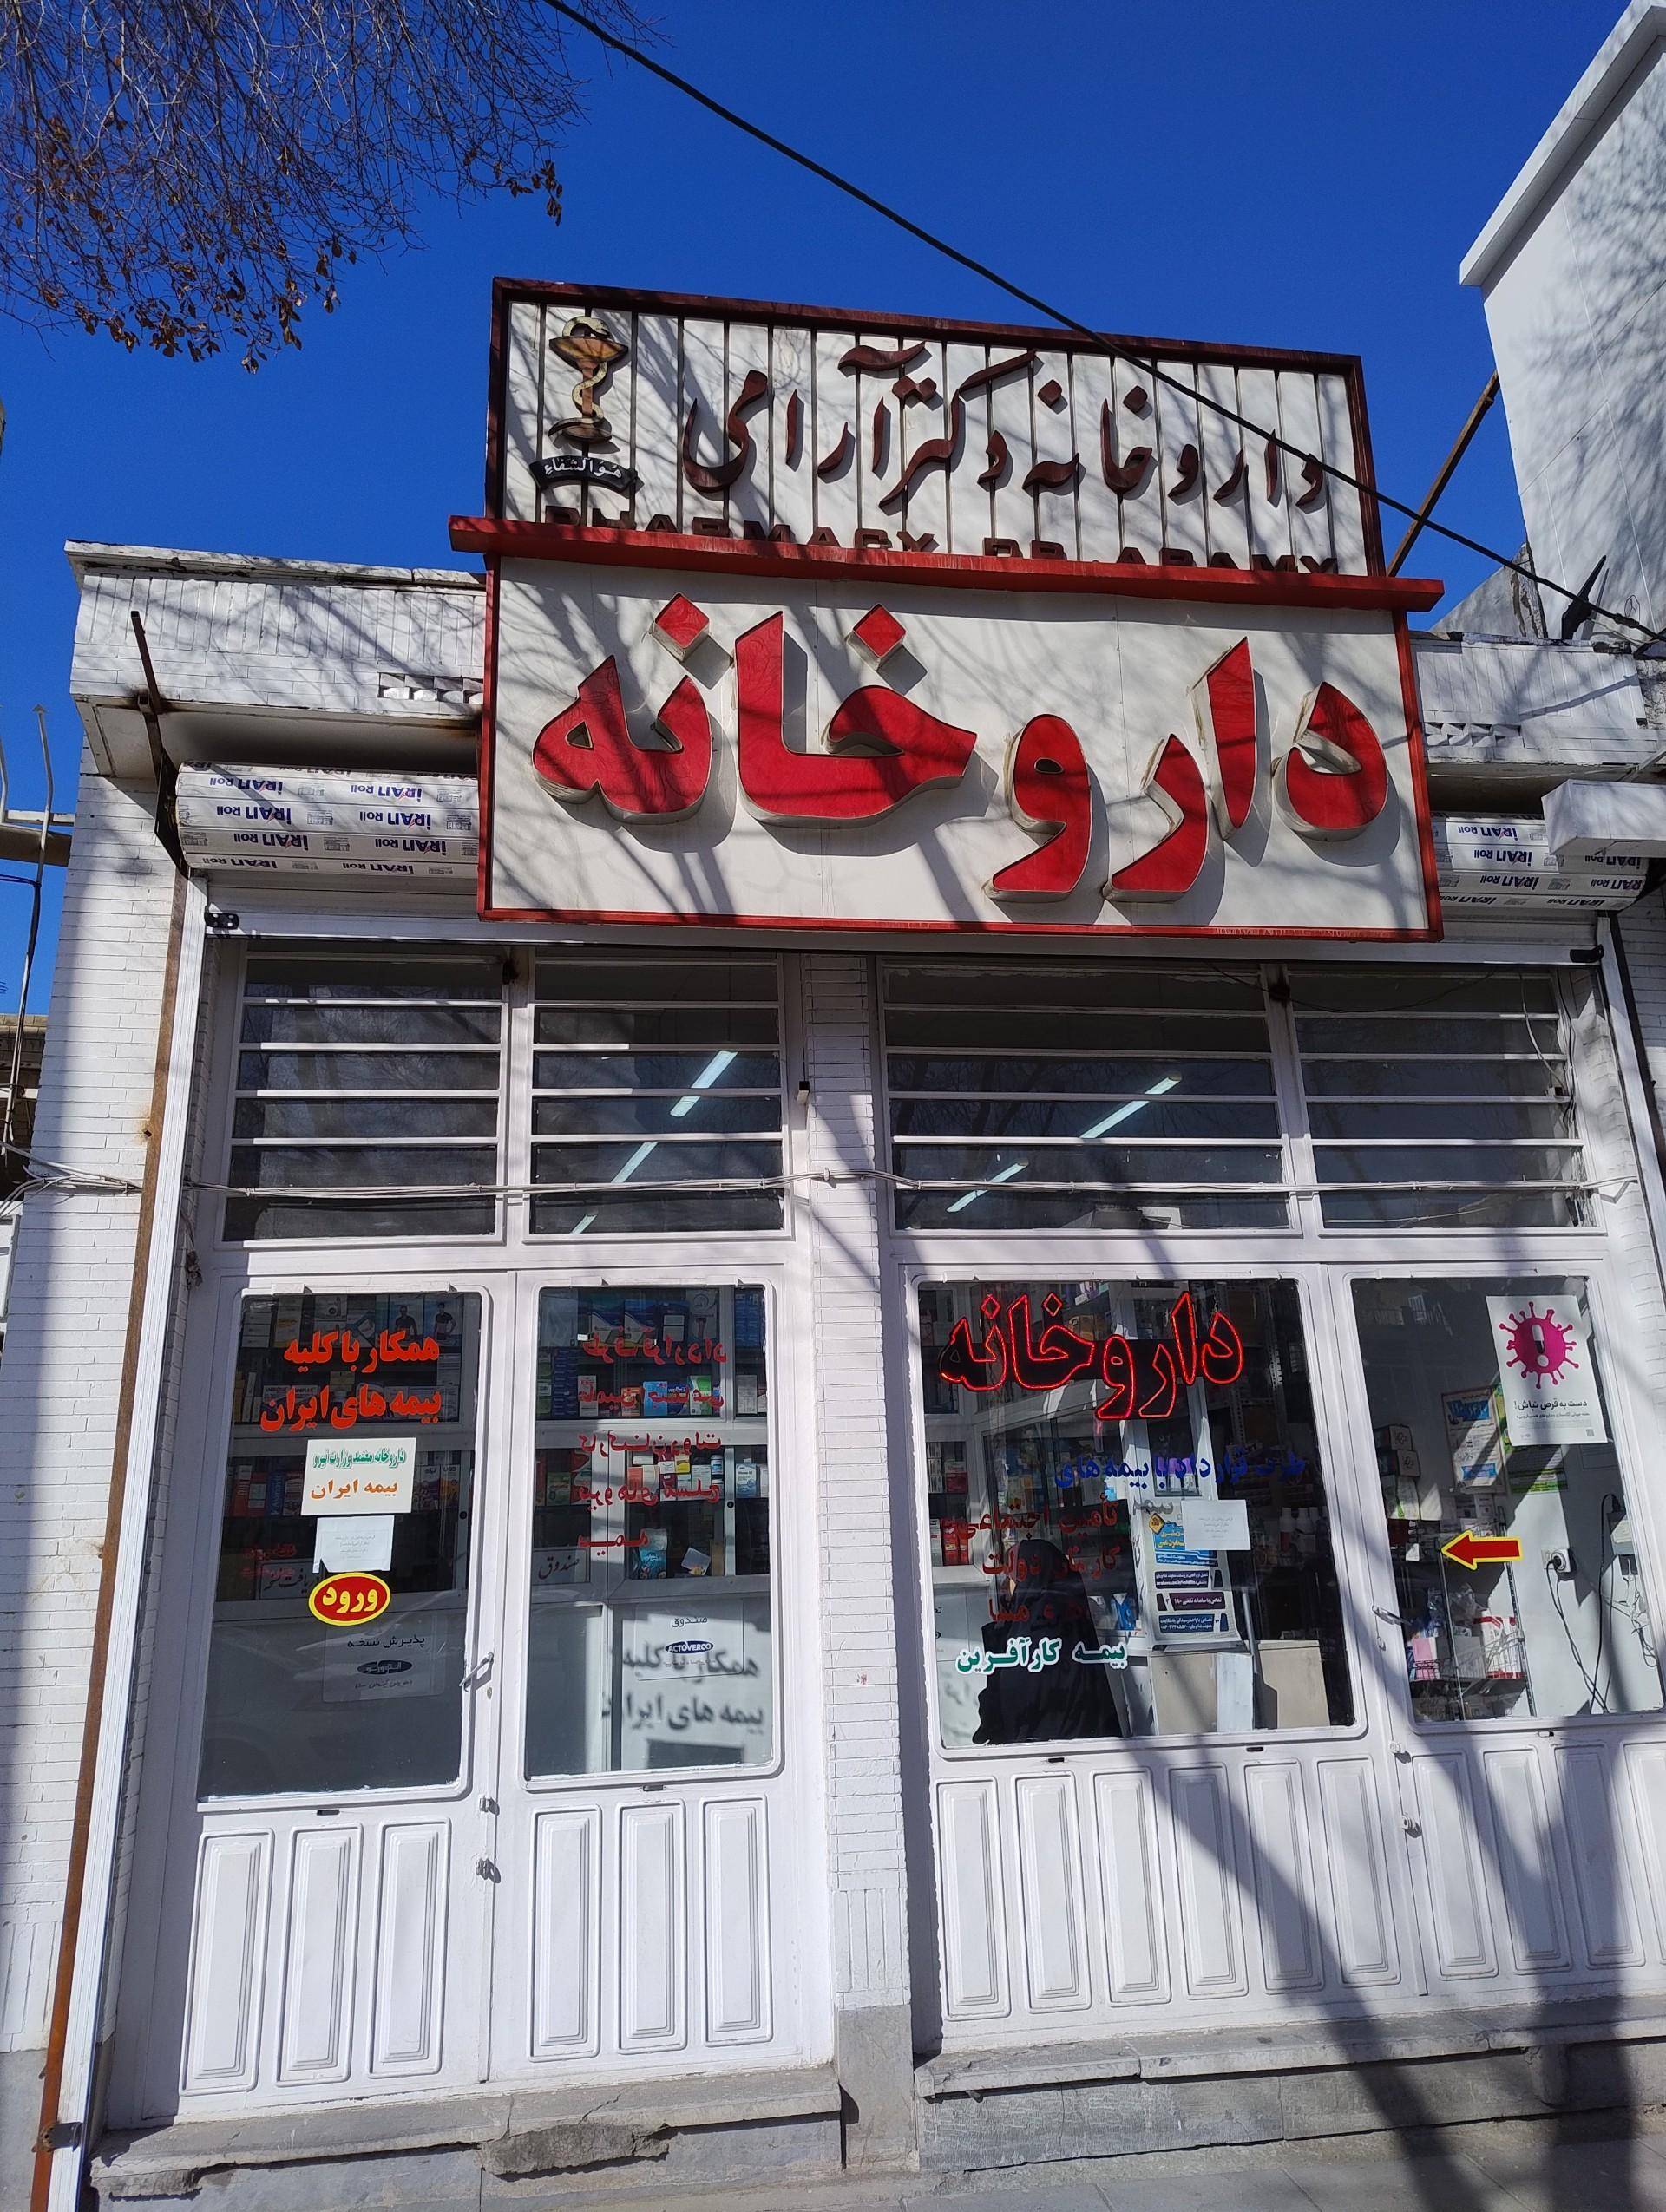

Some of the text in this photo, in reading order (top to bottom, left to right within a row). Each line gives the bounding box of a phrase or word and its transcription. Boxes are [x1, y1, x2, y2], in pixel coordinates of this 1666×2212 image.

[682, 341, 1325, 508] داروخانه دکتر آرامی
[531, 592, 1390, 903] داروخانه
[209, 777, 235, 787] Roll
[351, 784, 374, 795] Roll
[217, 805, 241, 816] Roll
[358, 811, 384, 822] Roll
[1458, 826, 1478, 834] Roll
[233, 833, 259, 844] Roll
[374, 838, 399, 848] Roll
[1473, 849, 1493, 859] Roll
[1479, 875, 1501, 884] Roll
[1590, 879, 1610, 887] Roll
[283, 1328, 440, 1374] همکار با کلیه
[938, 1290, 1243, 1421] داروخانه
[259, 1382, 443, 1432] بیمه های ایران
[1540, 1397, 1558, 1410] قرص
[375, 1448, 406, 1468] داروخانه
[311, 1477, 398, 1500] بیمه ایران
[538, 1556, 580, 1580] صندوق
[322, 1586, 379, 1613] ورود
[671, 1616, 708, 1627] صندوق
[346, 1633, 425, 1649] پذیرش نسخه
[667, 1640, 712, 1652] ACTOVERCO
[955, 1636, 1128, 1676] بیمه کارآفرین
